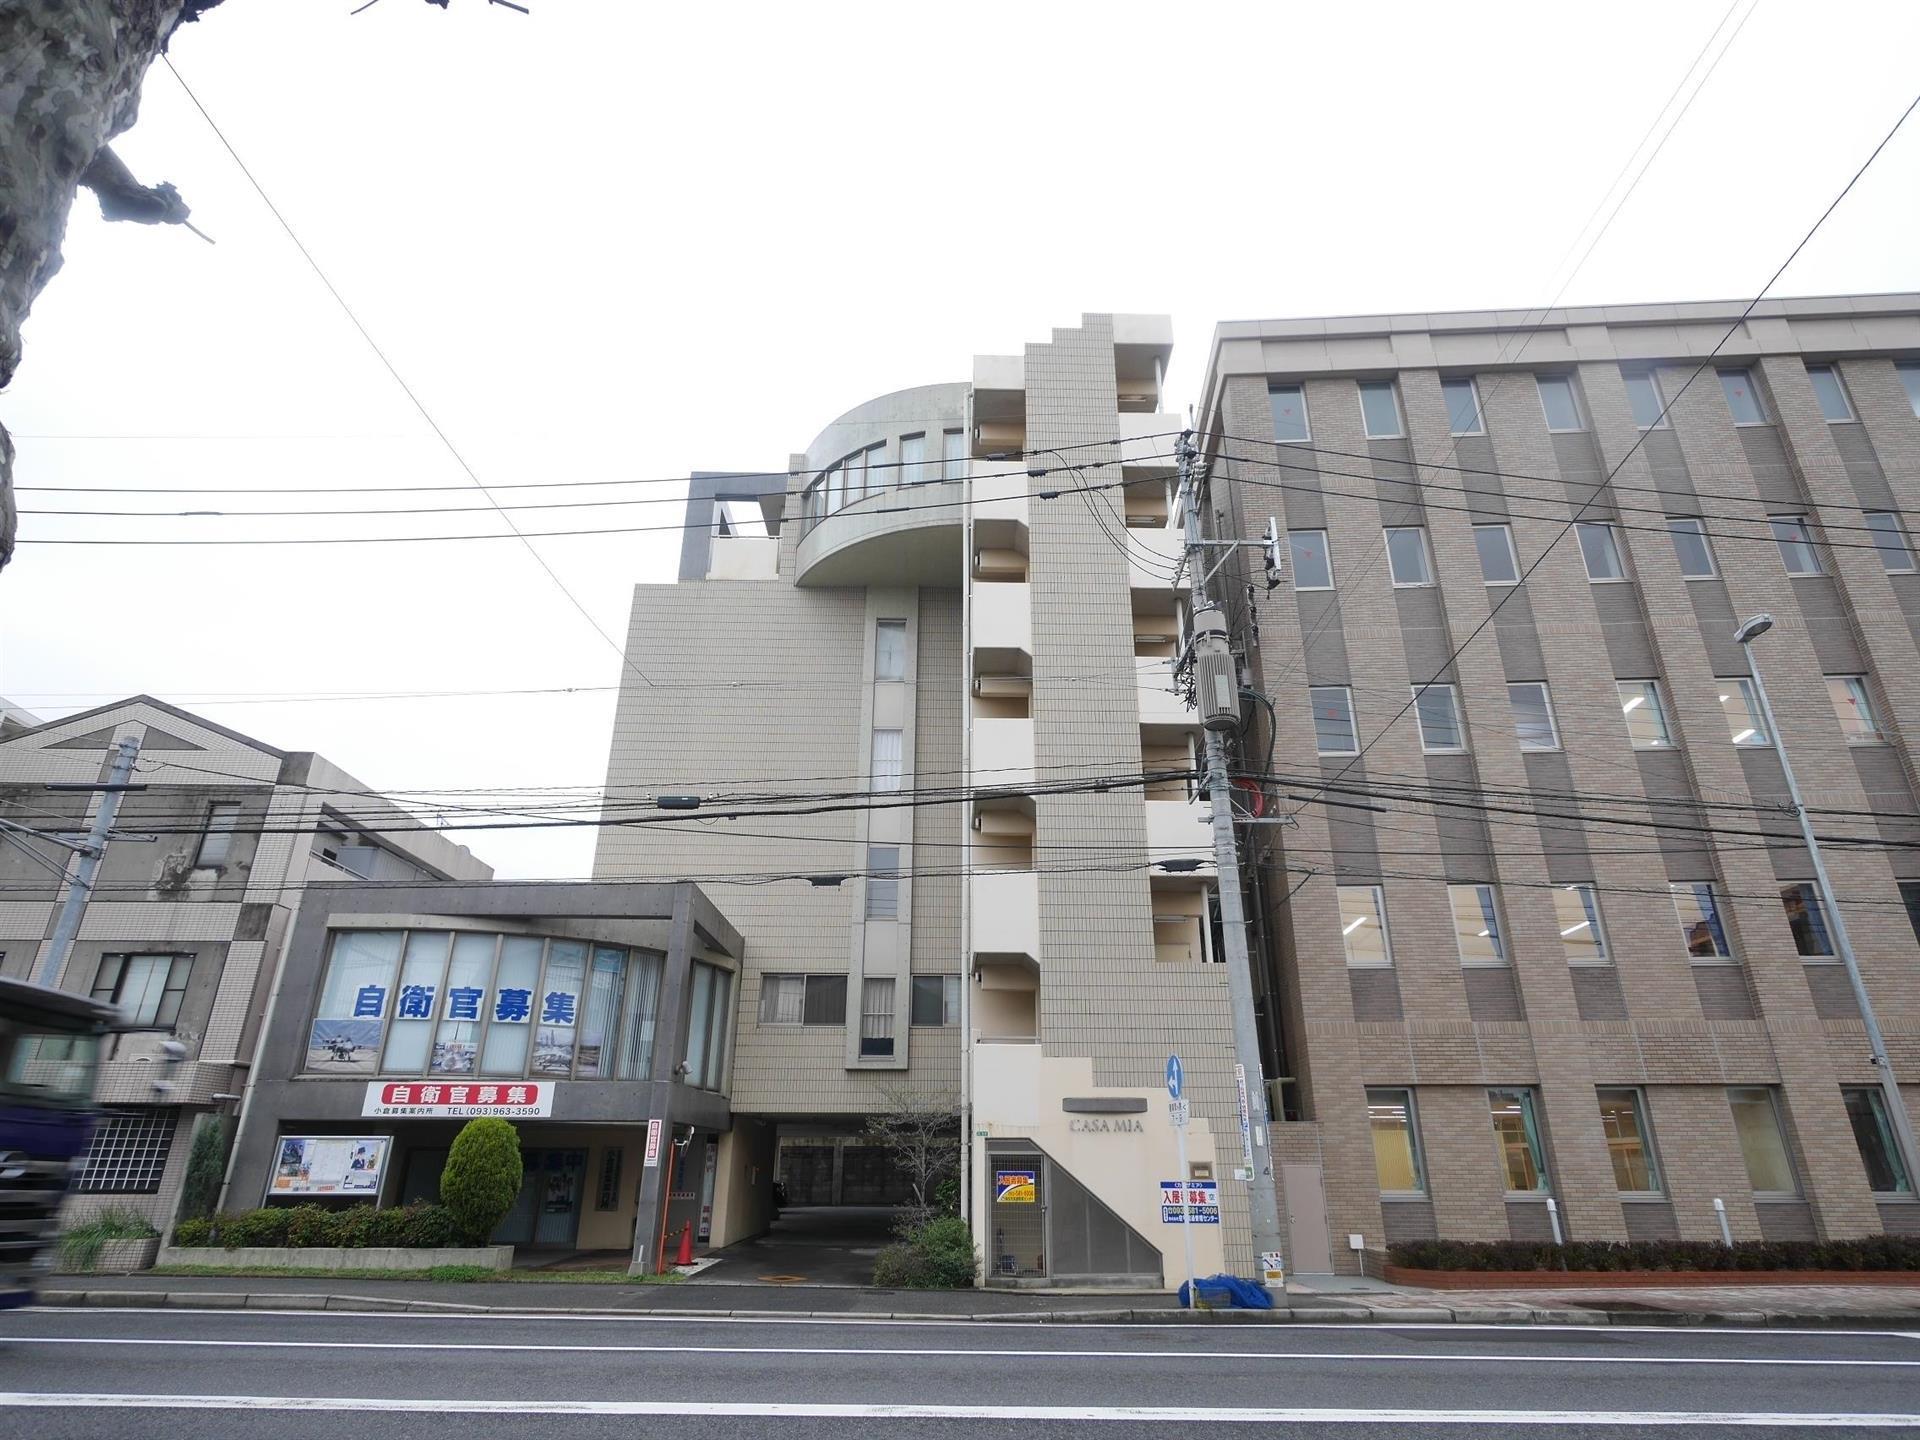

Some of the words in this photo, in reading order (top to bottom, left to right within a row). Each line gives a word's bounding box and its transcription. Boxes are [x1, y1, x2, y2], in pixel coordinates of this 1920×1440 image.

[353, 984, 576, 1024] 自衛官募集
[390, 1086, 527, 1104] 自衛官募集
[1069, 1119, 1110, 1133] CASA
[1114, 1119, 1144, 1132] MIA
